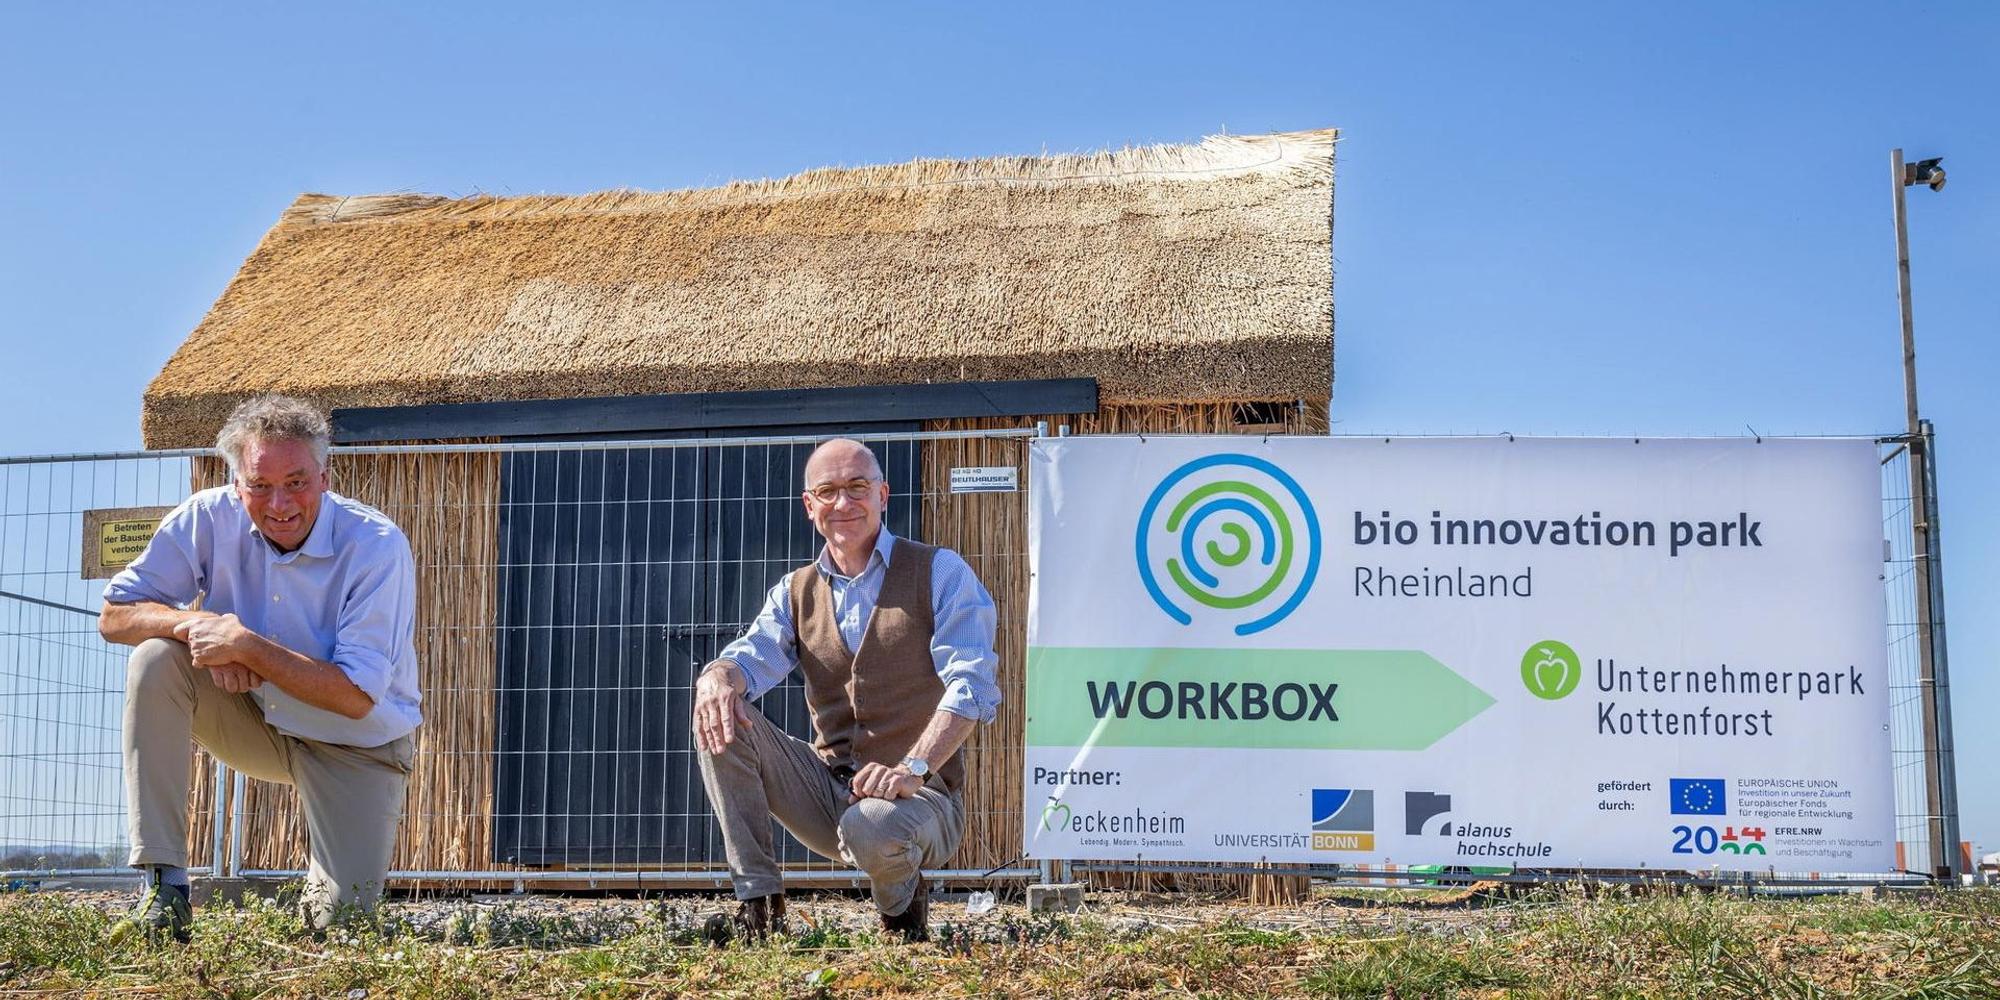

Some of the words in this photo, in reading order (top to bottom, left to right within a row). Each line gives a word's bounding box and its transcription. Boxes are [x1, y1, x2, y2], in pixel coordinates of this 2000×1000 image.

[114, 523, 152, 532] Betreten
[1353, 511, 1418, 545] bio
[1430, 511, 1655, 546] innovation
[1670, 512, 1763, 557] park
[111, 545, 148, 554] verbote
[1354, 566, 1532, 597] Rheinland
[1598, 658, 1864, 701] Unternehmerpark
[1086, 681, 1339, 721] WORKBOX
[1598, 702, 1773, 736] Kottenforst
[1034, 767, 1121, 786] Partner:
[1597, 780, 1651, 792] gefördert
[1738, 778, 1804, 788] EUROPÄISCHE
[1807, 780, 1838, 788] UNION
[1738, 789, 1779, 797] Investition
[1820, 790, 1851, 798] Zukunft
[1599, 801, 1634, 810] durch:
[1738, 799, 1798, 808] Europäischer
[1800, 800, 1827, 808] Fonds
[1754, 809, 1796, 818] regionale
[1798, 809, 1853, 819] Entwicklung
[1457, 823, 1512, 838] alanus
[1775, 827, 1823, 836] EFRE.NRW
[1080, 838, 1110, 846] Lebendig.
[1214, 832, 1310, 849] UNIVERSITÄT
[1315, 836, 1359, 850] BONN
[1838, 838, 1882, 847] Wachstum
[1457, 842, 1552, 857] hochschule
[1776, 848, 1792, 856] und
[1793, 848, 1853, 858] Beschäftigung
